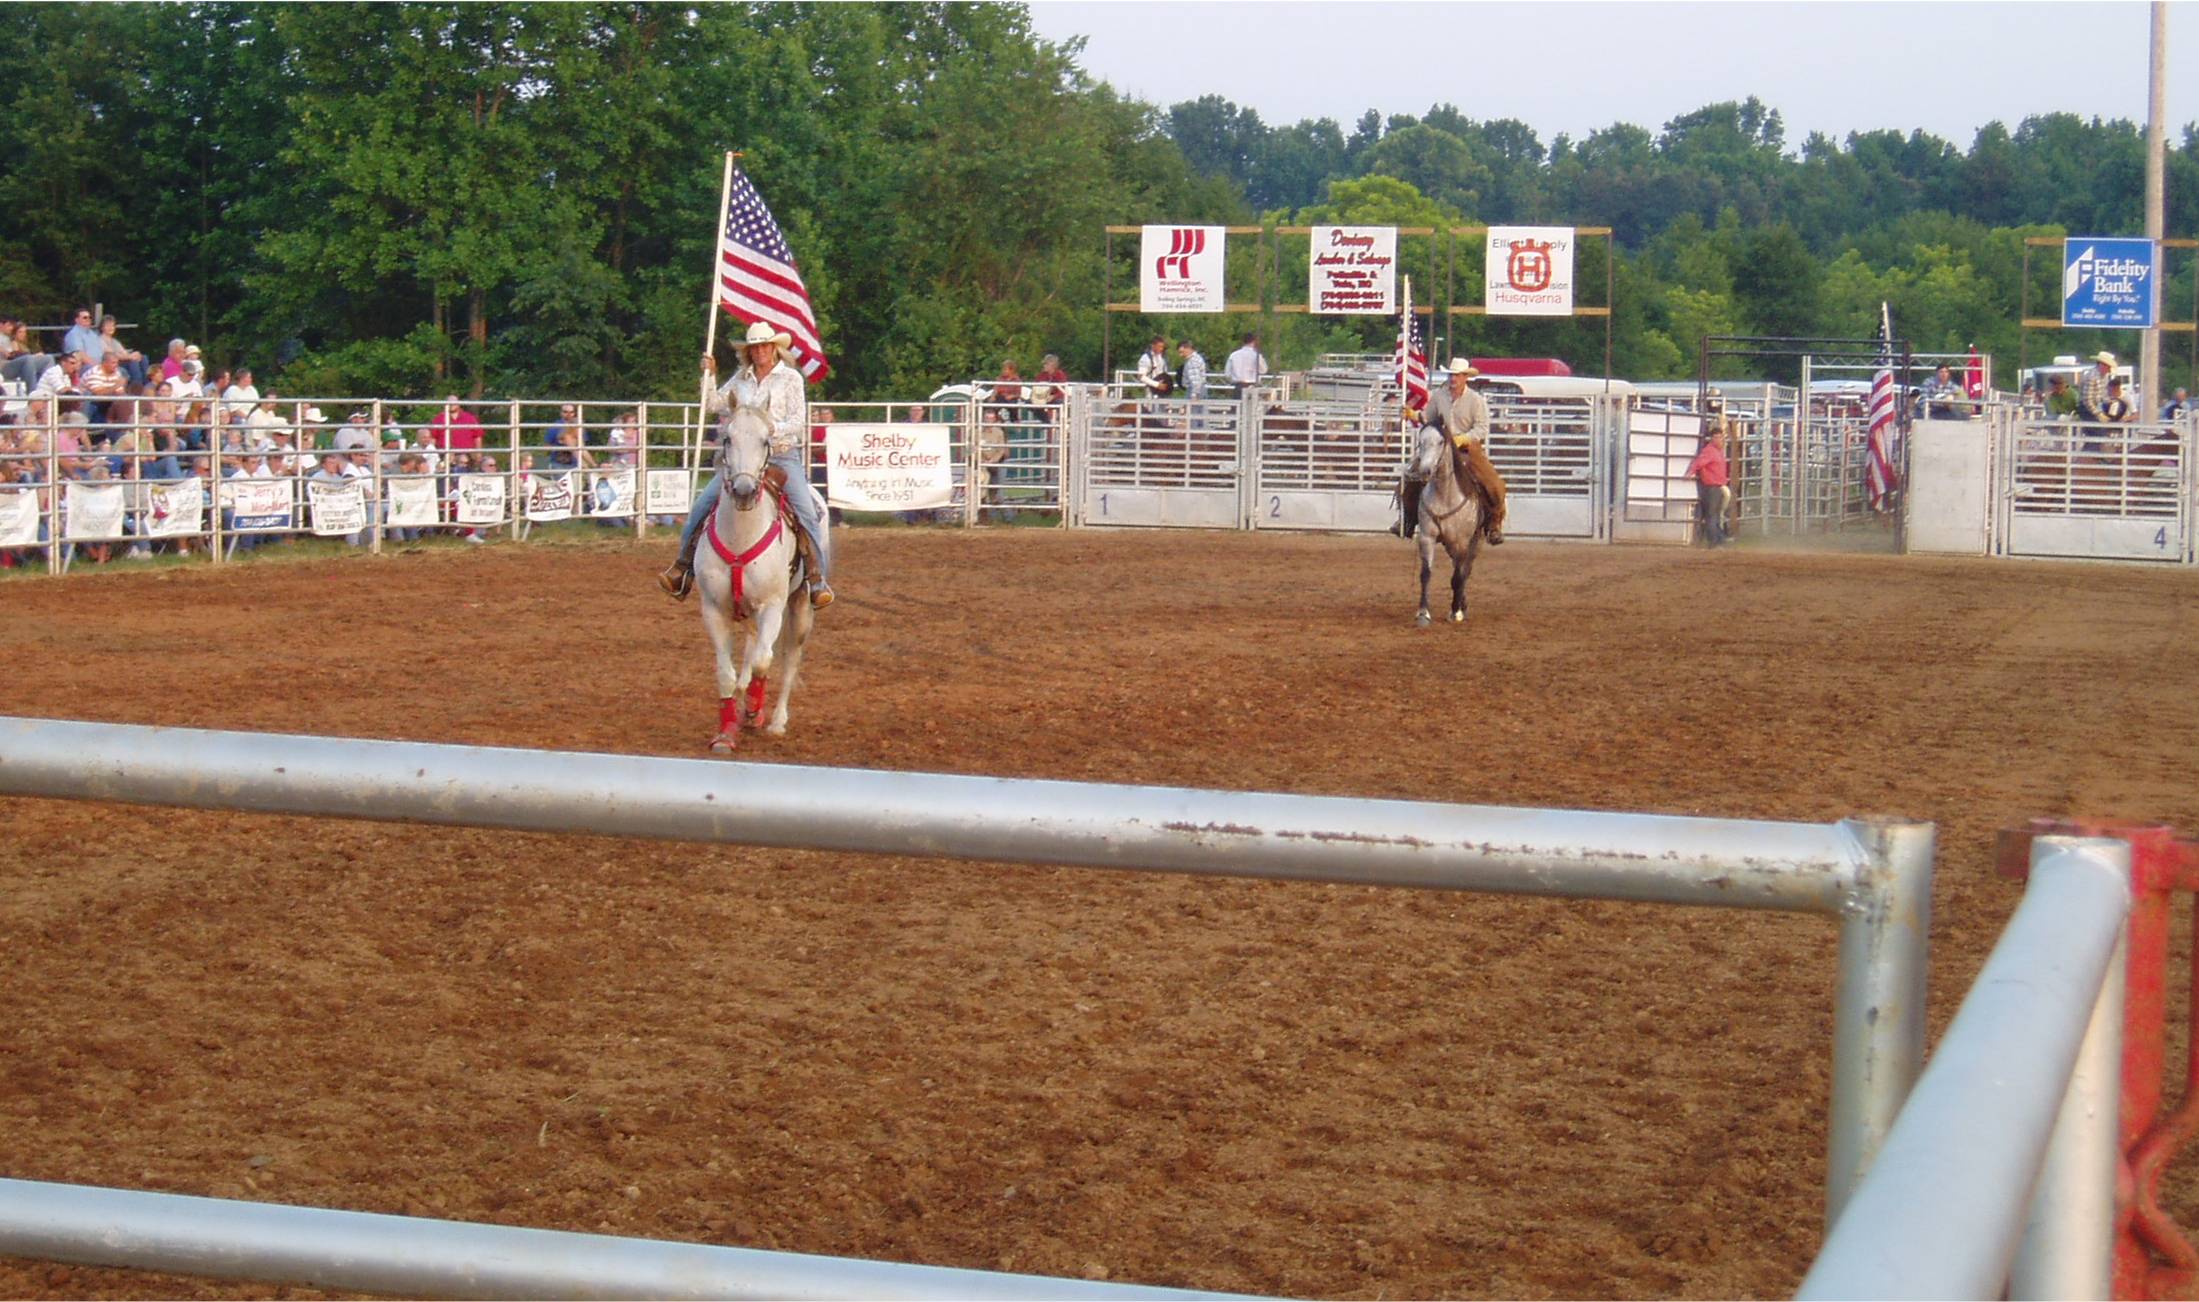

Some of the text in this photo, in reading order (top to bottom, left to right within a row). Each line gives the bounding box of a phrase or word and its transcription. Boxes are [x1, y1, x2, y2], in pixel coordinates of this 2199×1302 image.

[2094, 259, 2150, 281] Fidelity
[2094, 275, 2134, 293] Bank
[1495, 292, 1562, 305] Husqvarna
[862, 433, 917, 451] Shelby
[838, 451, 941, 467] Music Center
[1100, 493, 1109, 516] 1
[1270, 495, 1282, 518] 2
[2154, 526, 2167, 549] 4
